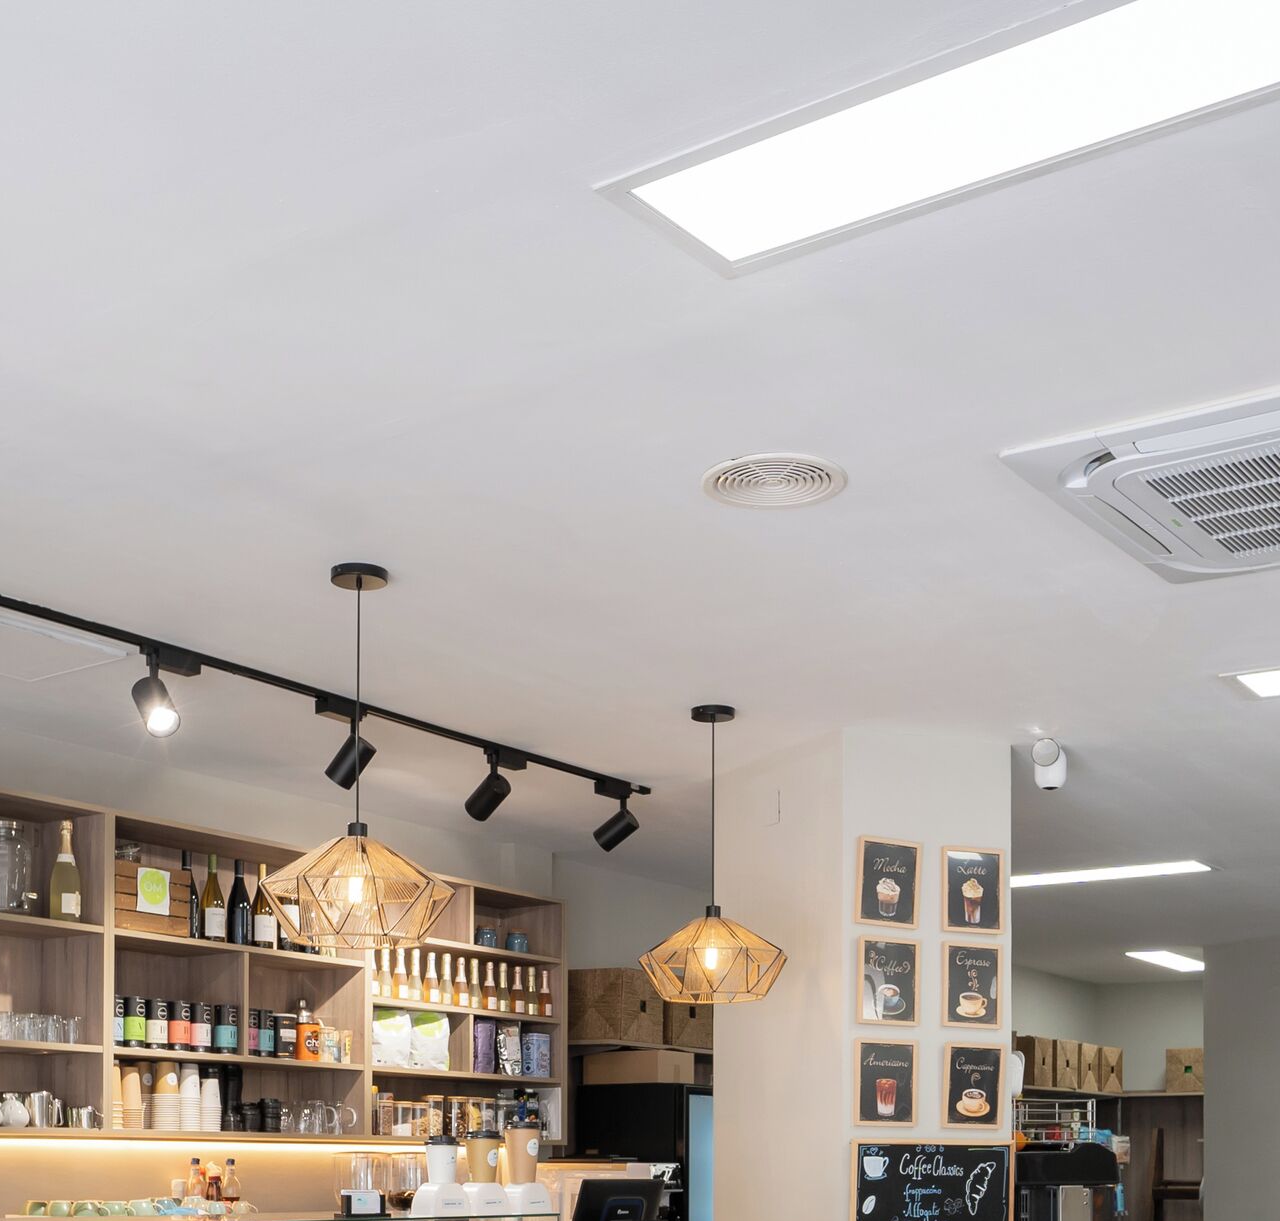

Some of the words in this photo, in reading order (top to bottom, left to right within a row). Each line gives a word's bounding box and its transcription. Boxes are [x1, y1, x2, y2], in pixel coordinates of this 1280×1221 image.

[873, 857, 907, 874] Mocha
[956, 863, 987, 876] Latte
[875, 955, 906, 976] Coffee
[956, 950, 992, 971] Espresso
[863, 1053, 909, 1069] Americano
[955, 1056, 995, 1074] Cappuccino
[899, 1153, 931, 1180] Coffee
[933, 1154, 964, 1177] Classics
